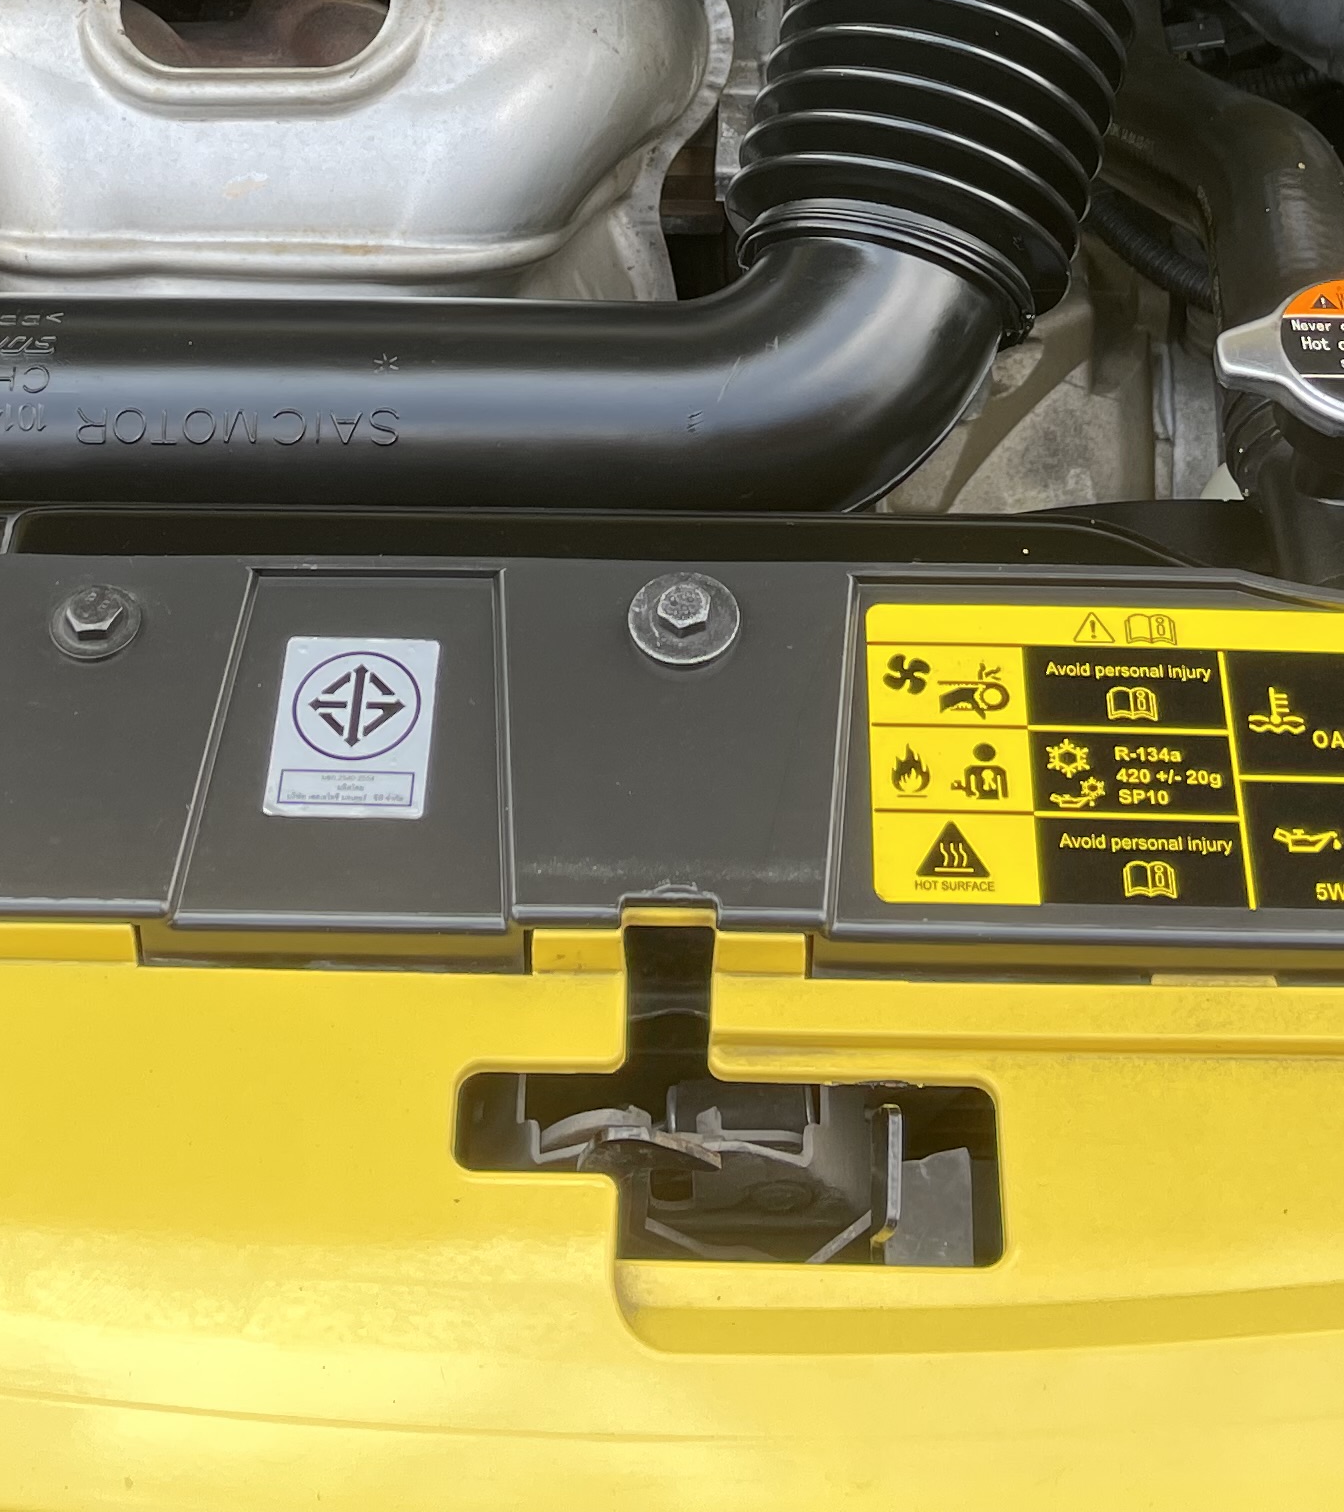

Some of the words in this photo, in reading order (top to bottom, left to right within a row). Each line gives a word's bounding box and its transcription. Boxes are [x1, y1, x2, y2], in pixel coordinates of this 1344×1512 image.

[1291, 319, 1331, 332] Never
[1300, 336, 1330, 351] Hot
[75, 407, 258, 446] MOTOR
[273, 407, 401, 446] SAIC
[1045, 661, 1091, 678] Avoid
[1095, 662, 1163, 681] personal
[1167, 664, 1211, 682] injury
[1114, 746, 1182, 763] R-134a
[1115, 769, 1150, 784] 420
[1155, 769, 1182, 785] +/-
[1186, 770, 1222, 788] 20g
[1118, 790, 1168, 806] SP10
[1059, 832, 1106, 849] Avoid
[1111, 834, 1182, 852] personal
[1187, 836, 1233, 856] injury
[914, 880, 939, 892] HOT
[941, 880, 996, 893] SURFACE
